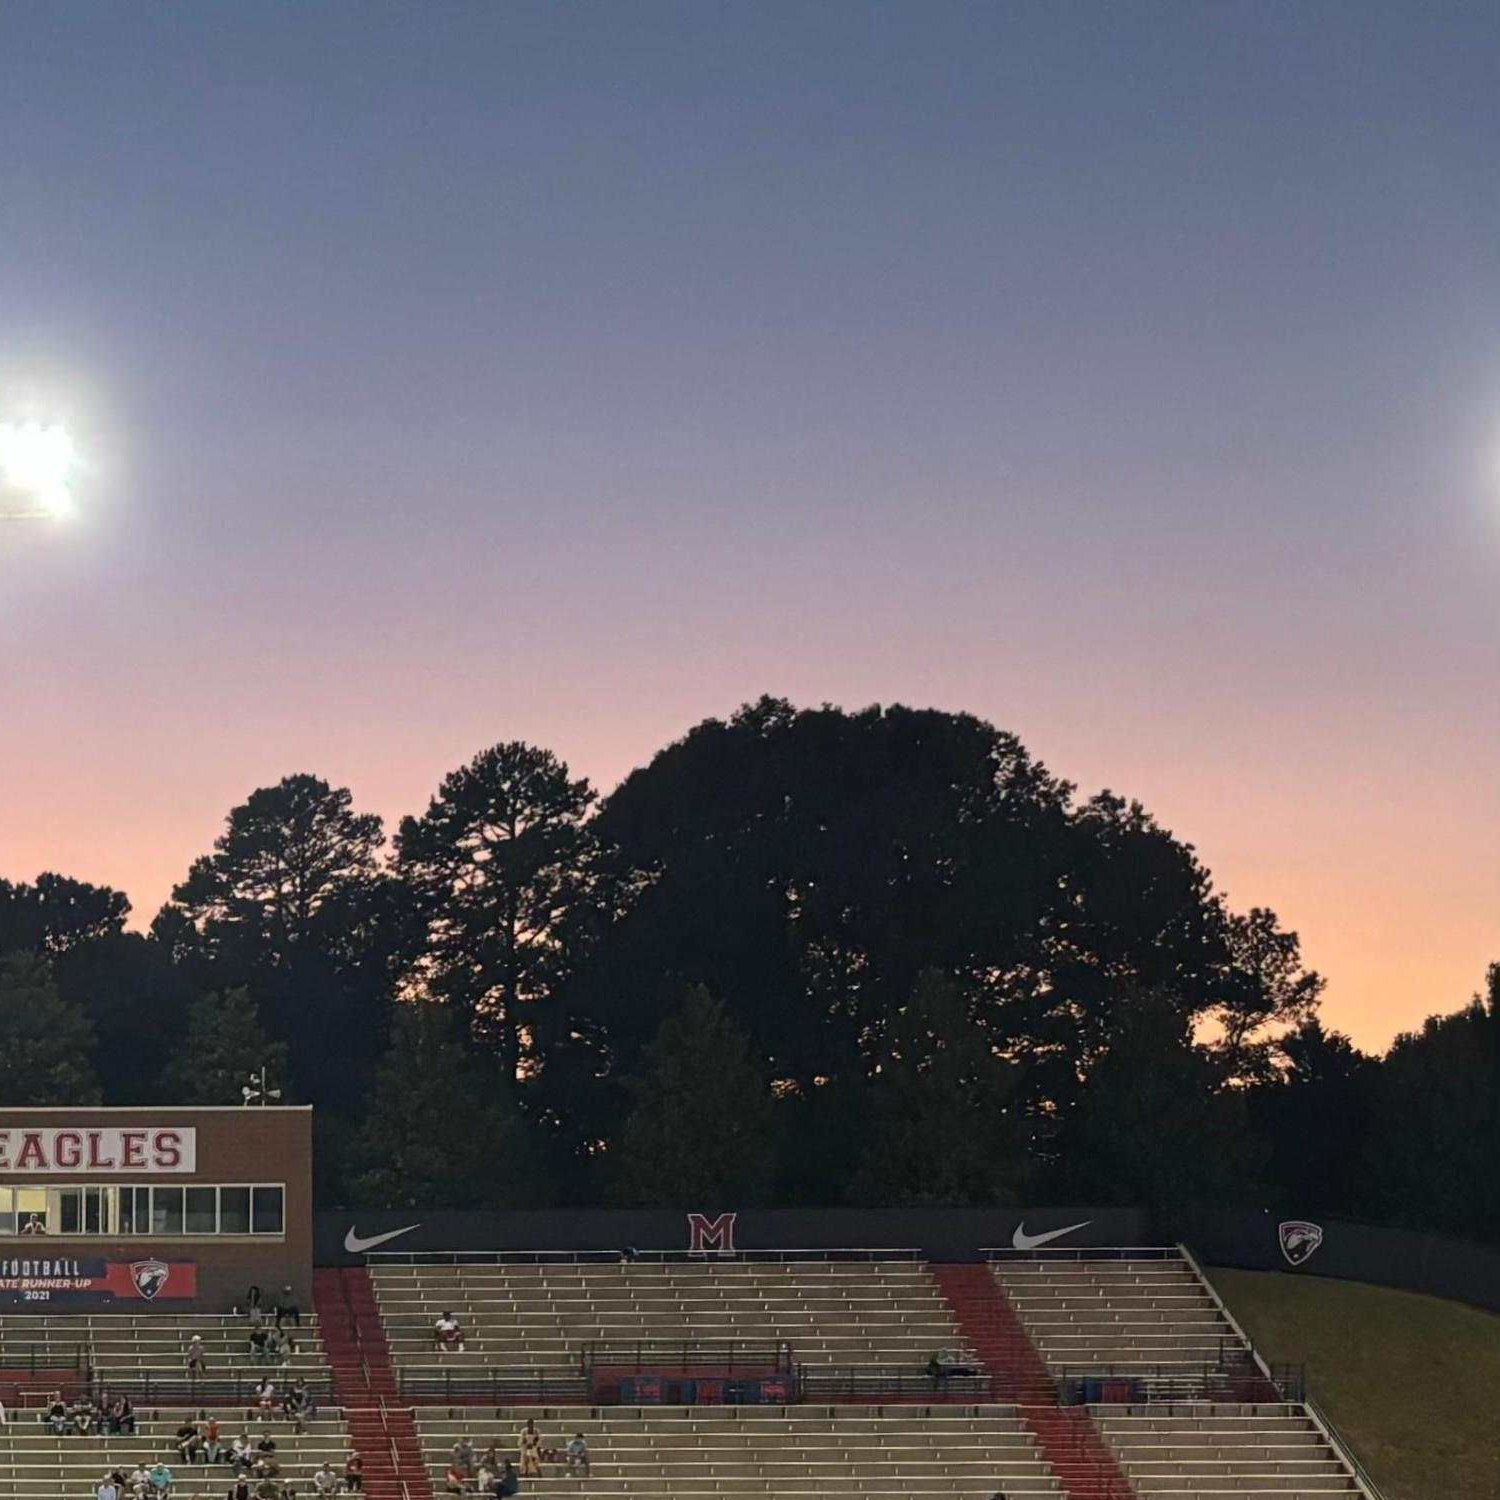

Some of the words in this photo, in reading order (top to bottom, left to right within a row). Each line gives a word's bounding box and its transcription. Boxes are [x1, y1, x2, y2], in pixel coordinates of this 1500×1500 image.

[687, 1213, 737, 1257] M
[2, 1260, 80, 1276] FOOTBALL
[21, 1279, 92, 1289] RUNNER-UP
[25, 1290, 50, 1300] 2021
